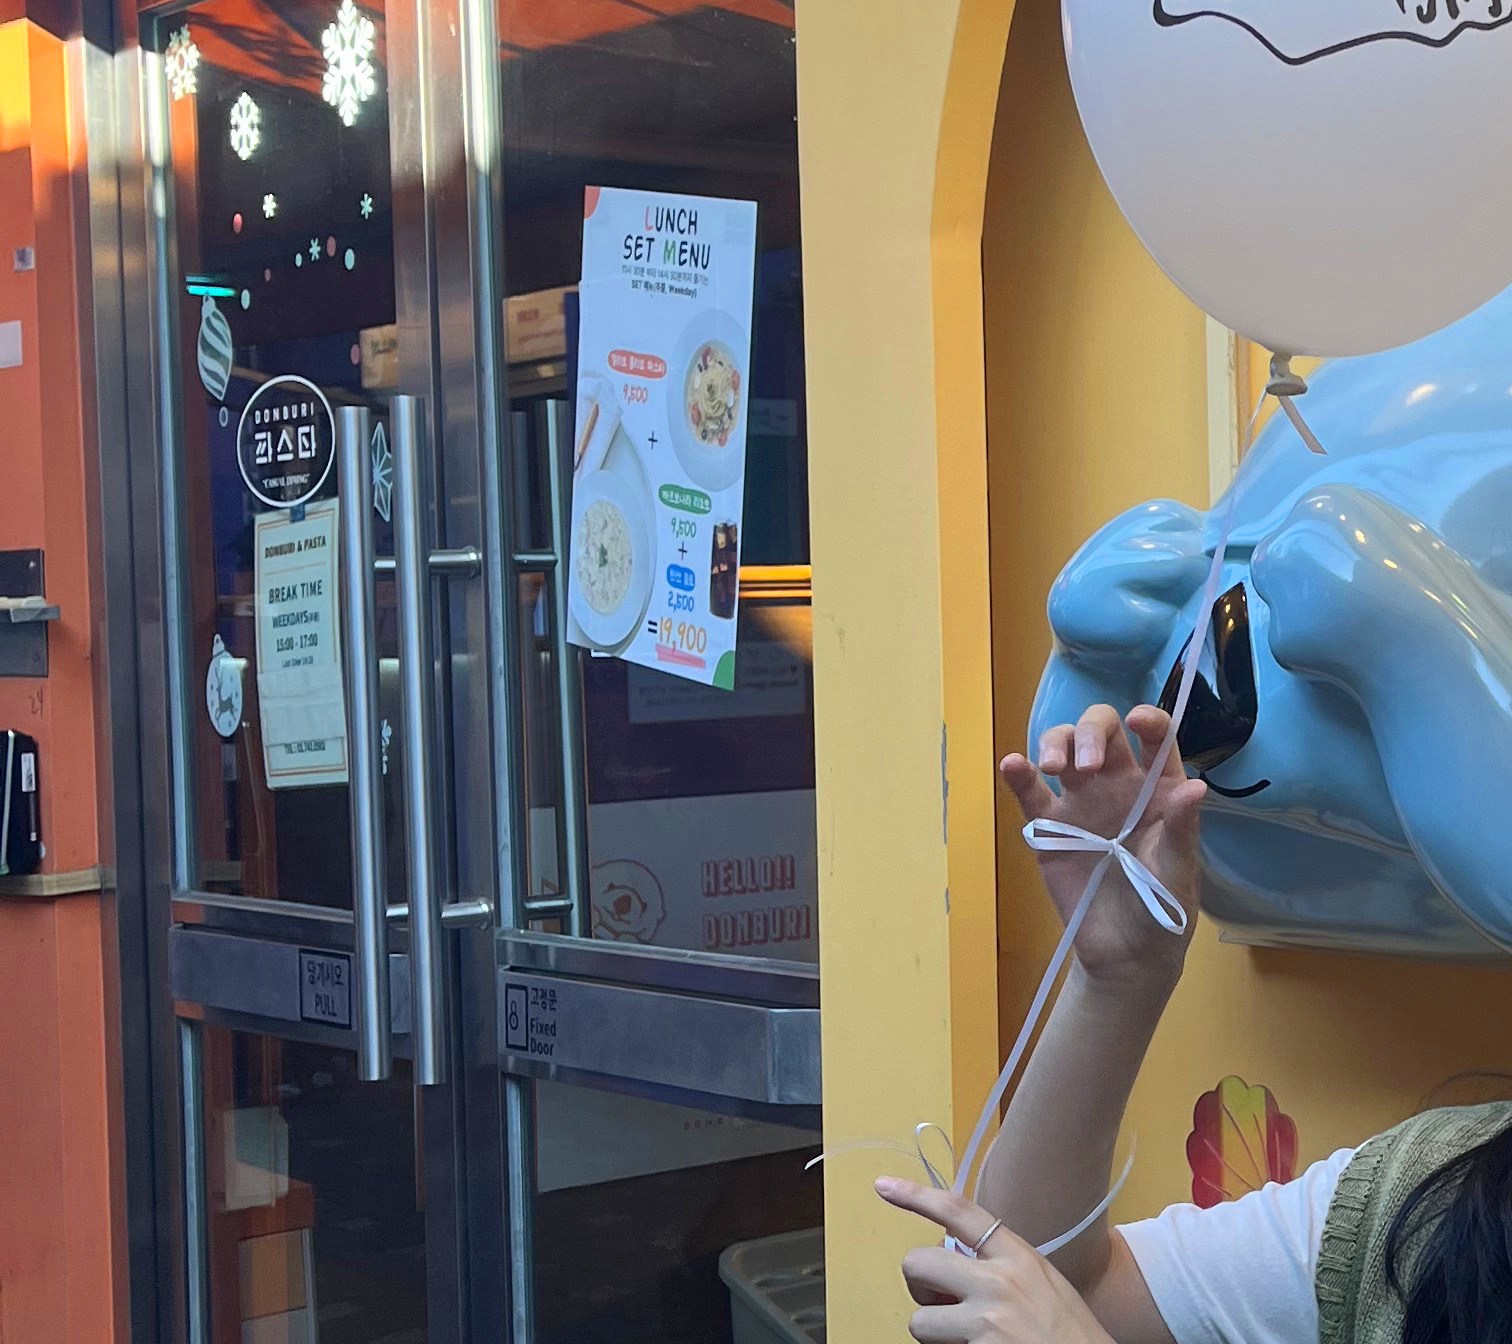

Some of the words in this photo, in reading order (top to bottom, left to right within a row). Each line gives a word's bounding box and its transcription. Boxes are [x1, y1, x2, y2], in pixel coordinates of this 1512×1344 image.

[644, 205, 698, 235] LUNCH
[623, 234, 655, 263] SET
[663, 239, 711, 270] MENU
[624, 383, 648, 405] 9,500
[254, 401, 315, 425] DONBURI
[254, 424, 317, 465] 파스타
[671, 517, 697, 538] 9,500
[303, 535, 327, 551] PASTA
[268, 583, 298, 605] BREAK
[300, 579, 323, 599] TIME
[668, 590, 695, 612] 2,500
[702, 854, 797, 898] HELLO!!
[307, 959, 344, 988] 당기시오
[314, 993, 337, 1017] PULL
[530, 987, 557, 1011] 고정문
[530, 1017, 557, 1036] Fixed
[530, 1037, 554, 1056] Door
